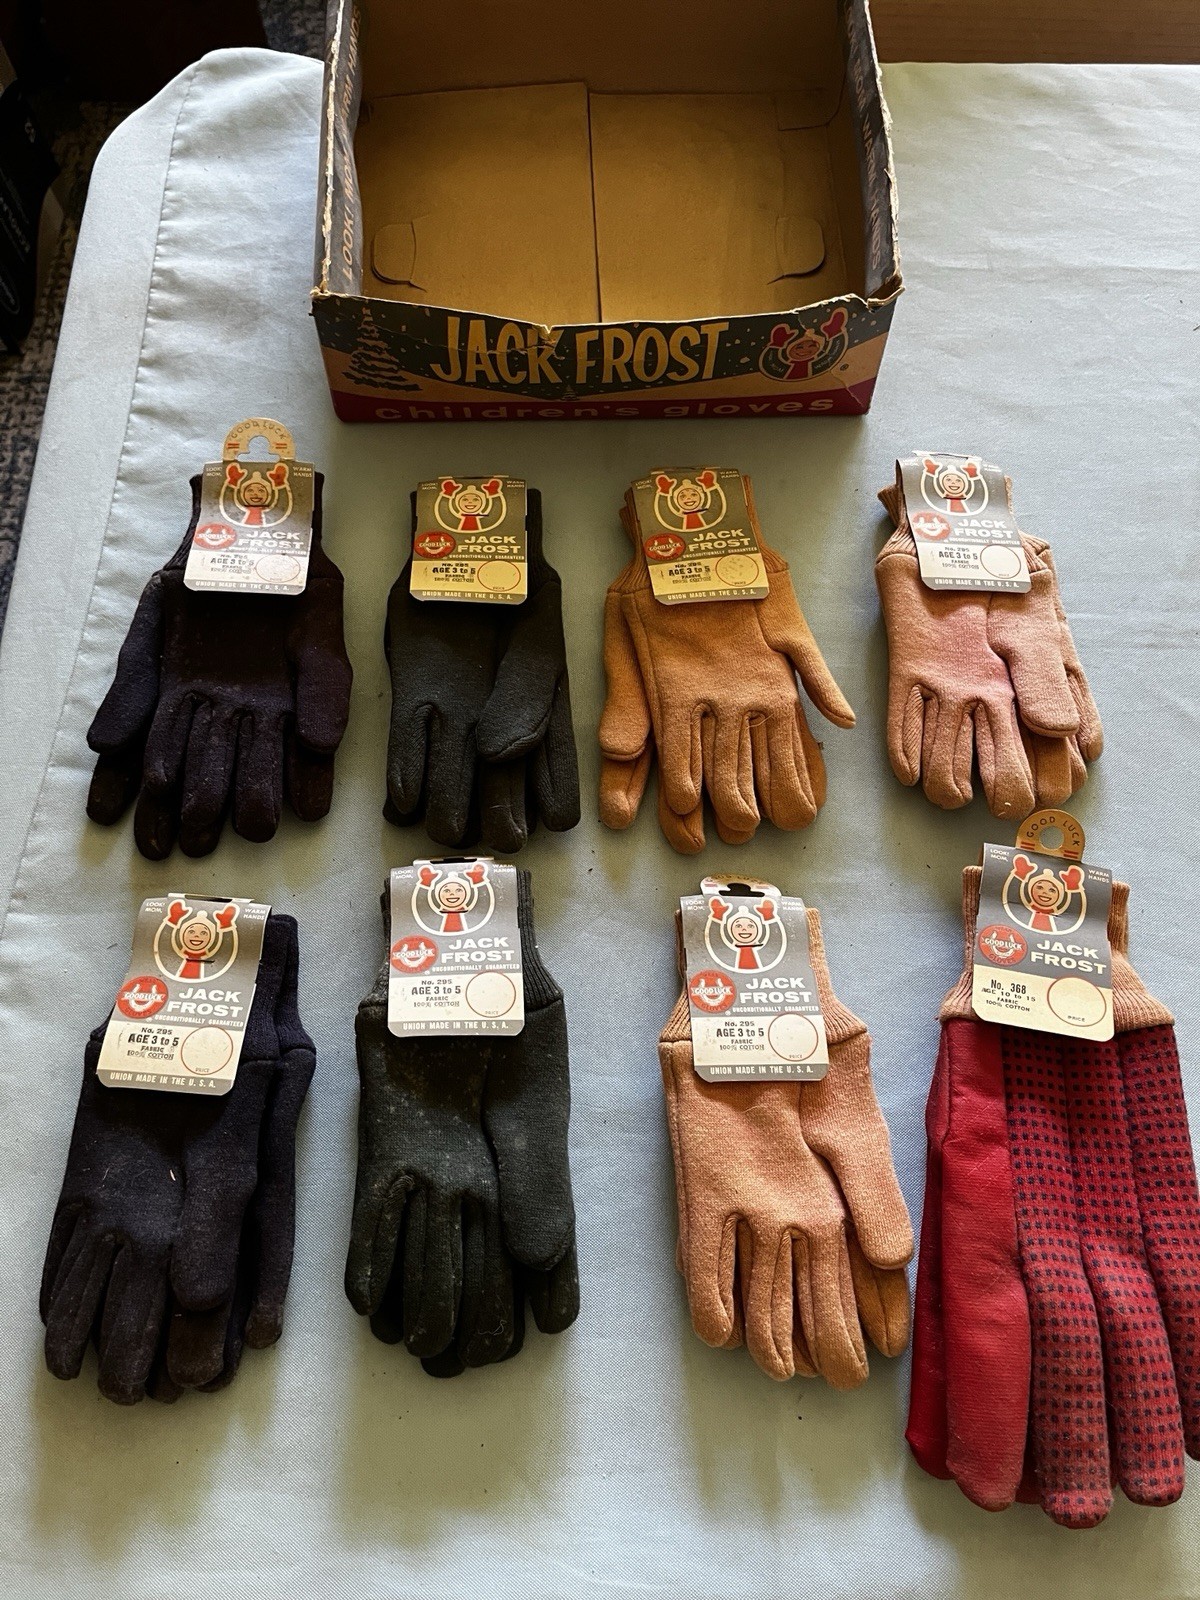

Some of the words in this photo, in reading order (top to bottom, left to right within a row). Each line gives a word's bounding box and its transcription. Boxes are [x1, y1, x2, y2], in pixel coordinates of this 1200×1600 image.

[430, 316, 564, 384] JACK
[575, 321, 729, 384] FROST
[375, 405, 640, 420] children's
[664, 398, 835, 418] gloves
[263, 420, 287, 440] LUCK
[958, 519, 1007, 529] JACK
[246, 531, 300, 540] JACK
[464, 535, 517, 544] JACK
[693, 529, 745, 542] JACK
[953, 528, 1013, 539] FROST
[238, 539, 304, 549] FROST
[457, 545, 521, 554] FROST
[688, 538, 751, 552] FROST
[668, 568, 686, 577] AGE
[704, 565, 711, 573] 5
[1026, 816, 1056, 838] GOOD
[1062, 820, 1080, 847] LUCK
[1088, 869, 1110, 877] WARM
[449, 937, 509, 950] JACK
[985, 938, 1004, 947] GOOD
[1005, 941, 1022, 950] LUCK
[1036, 940, 1099, 959] JACK
[441, 950, 515, 964] FROST
[1030, 951, 1107, 975] FROST
[746, 977, 805, 989] JACK
[991, 979, 1004, 990] No.
[1010, 983, 1027, 994] 368
[179, 988, 242, 1003] JACK
[411, 987, 431, 995] AGE
[434, 986, 440, 994] 3
[443, 986, 452, 994] to
[455, 986, 461, 994] 5
[740, 991, 812, 1004] FROST
[997, 997, 1019, 1005] FABRIC
[167, 1001, 243, 1017] FROST
[1005, 1003, 1031, 1012] COTTON
[155, 1014, 205, 1024] UNCONDITIONALLY
[403, 1022, 426, 1030] UNION
[464, 1021, 478, 1029] THE
[716, 1028, 735, 1037] AGE
[738, 1028, 744, 1037] 3
[746, 1028, 756, 1037] to
[758, 1028, 764, 1037] 5
[128, 1034, 149, 1044] AGE
[151, 1036, 157, 1045] 3
[160, 1036, 170, 1046] to
[172, 1037, 179, 1047] 5
[710, 1067, 732, 1075] UNION
[735, 1066, 755, 1074] MADE
[759, 1066, 767, 1074] IN
[769, 1066, 783, 1074] THE
[110, 1072, 132, 1081] UNION
[136, 1074, 156, 1083] MADE
[160, 1075, 169, 1084] IN
[172, 1076, 185, 1086] THE
